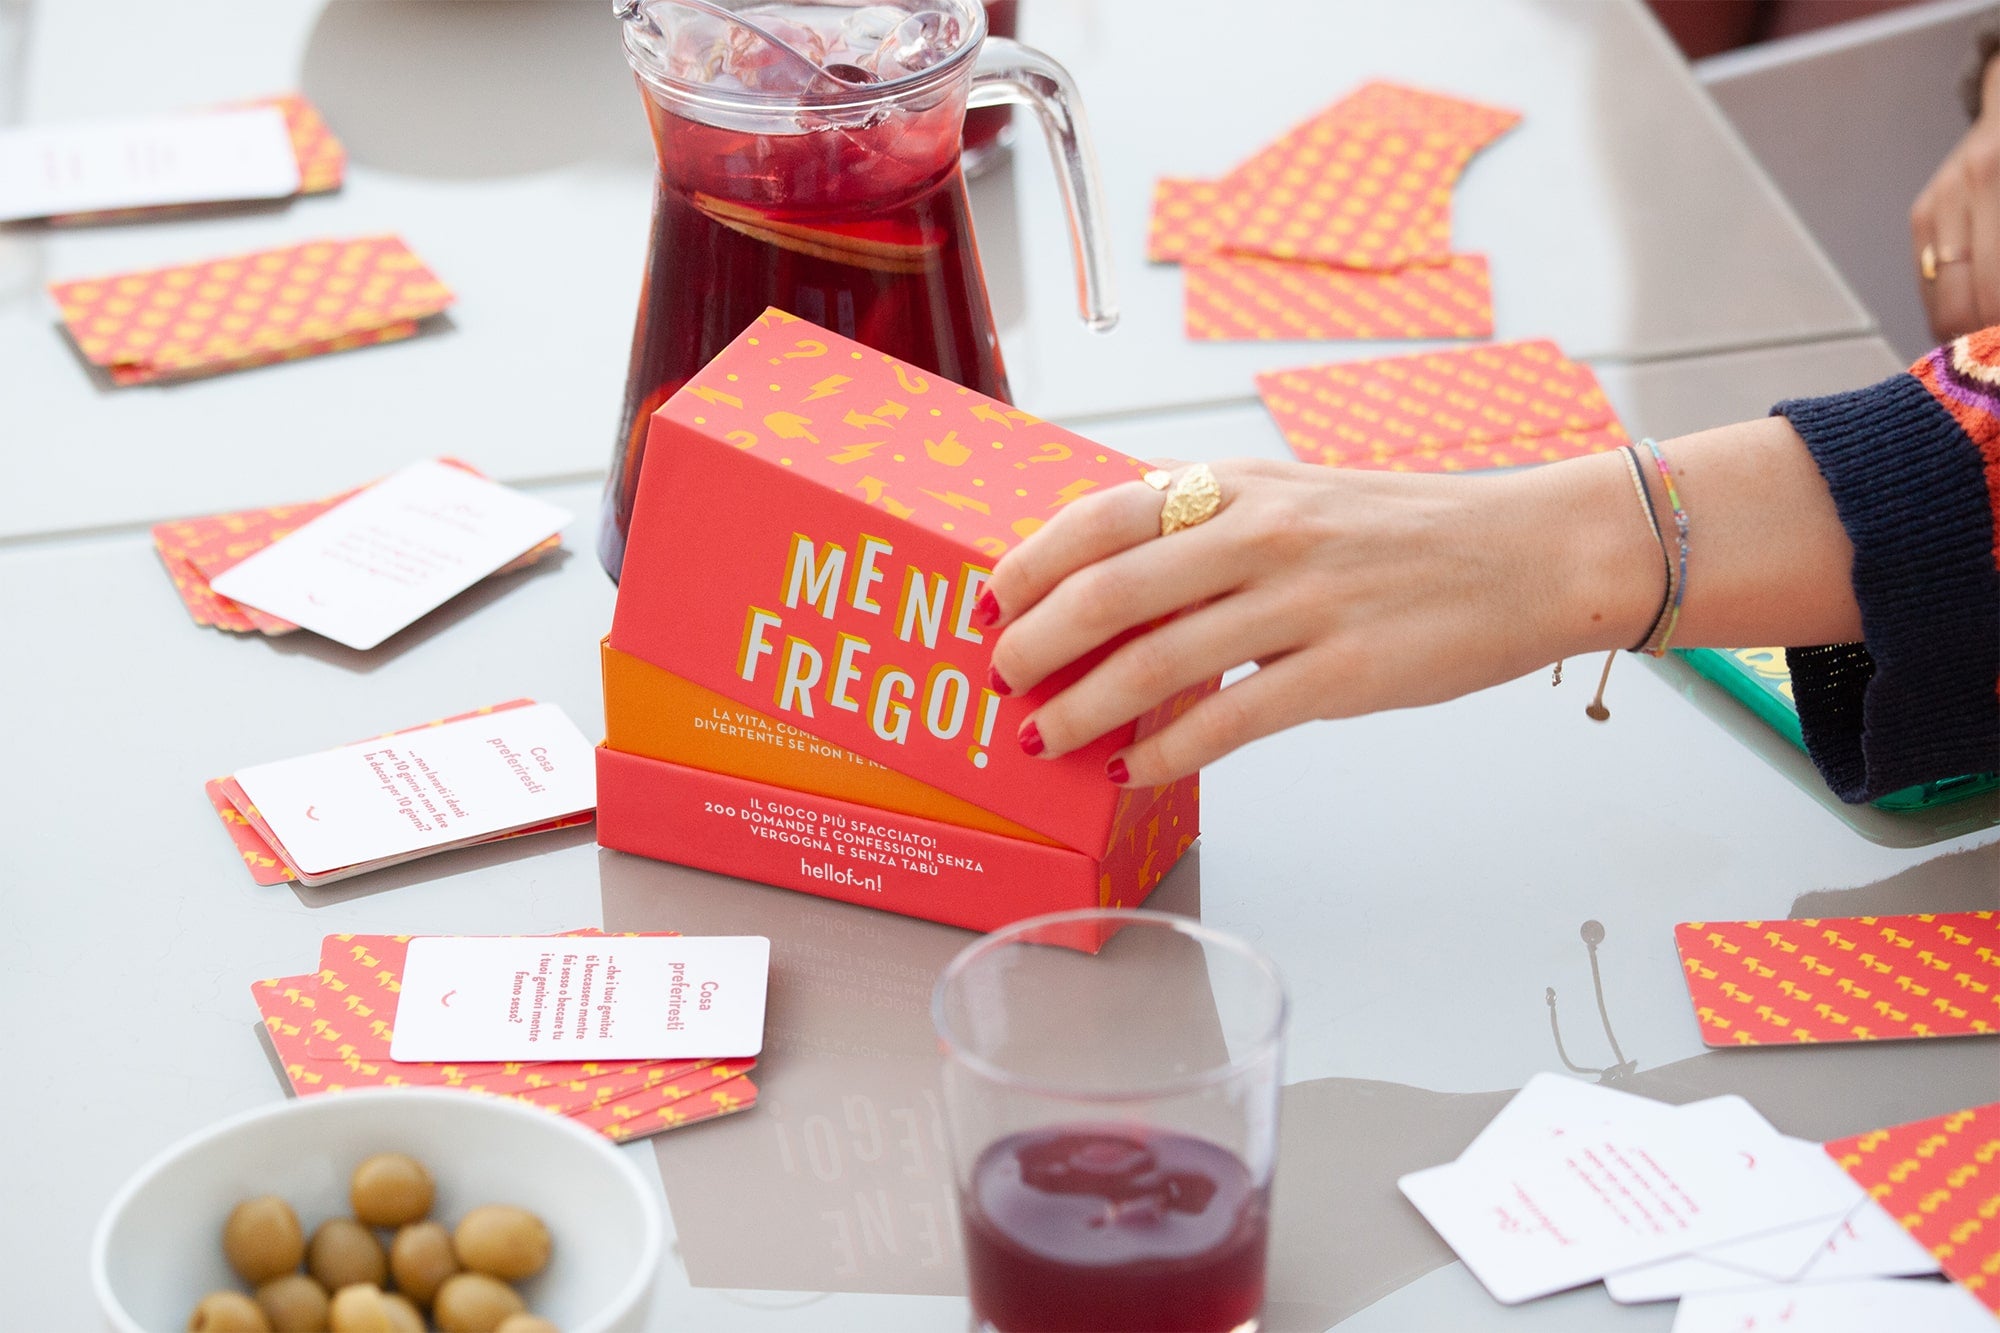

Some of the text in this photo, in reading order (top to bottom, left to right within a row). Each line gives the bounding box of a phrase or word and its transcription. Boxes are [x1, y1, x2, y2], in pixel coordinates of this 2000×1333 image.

[736, 605, 1000, 769] FREGO!
[713, 708, 730, 722] LA
[736, 712, 771, 731] VITA,
[379, 749, 398, 761] per
[694, 717, 784, 747] DIVERTENTE
[788, 738, 805, 752] SE
[810, 744, 842, 760] NON
[847, 751, 864, 765] TE
[394, 761, 410, 771] 10
[486, 738, 546, 793] preferiresti
[530, 747, 554, 772] Cosa
[363, 752, 432, 832] la doccia per 10 giorni?
[396, 772, 426, 793] giorni
[415, 758, 429, 772] non
[425, 771, 452, 795] lavarti
[446, 800, 469, 818] denti
[421, 799, 437, 813] non
[433, 813, 448, 829] fare
[704, 802, 984, 873] 200 DOMANDE E CONFESSIONI SENZA
[750, 798, 938, 849] IL GIOCO PIÙ SFACCIATO!
[750, 825, 939, 876] VERGOGNA E SENZA TABÙ
[539, 958, 552, 975] tuoi
[563, 954, 578, 965] fai
[607, 965, 621, 980] che
[532, 976, 549, 1009] genitori
[560, 967, 571, 988] sesso
[580, 963, 599, 1007] beccassero
[508, 971, 530, 1024] fanno sesso?
[604, 987, 617, 1003] tuoi
[667, 962, 690, 1031] preferiresti
[699, 981, 719, 1011] Cosa
[529, 1011, 541, 1042] mentre
[554, 998, 572, 1029] beccare
[576, 1009, 588, 1040] mentre
[597, 1005, 615, 1038] genitori
[552, 1031, 564, 1040] tu
